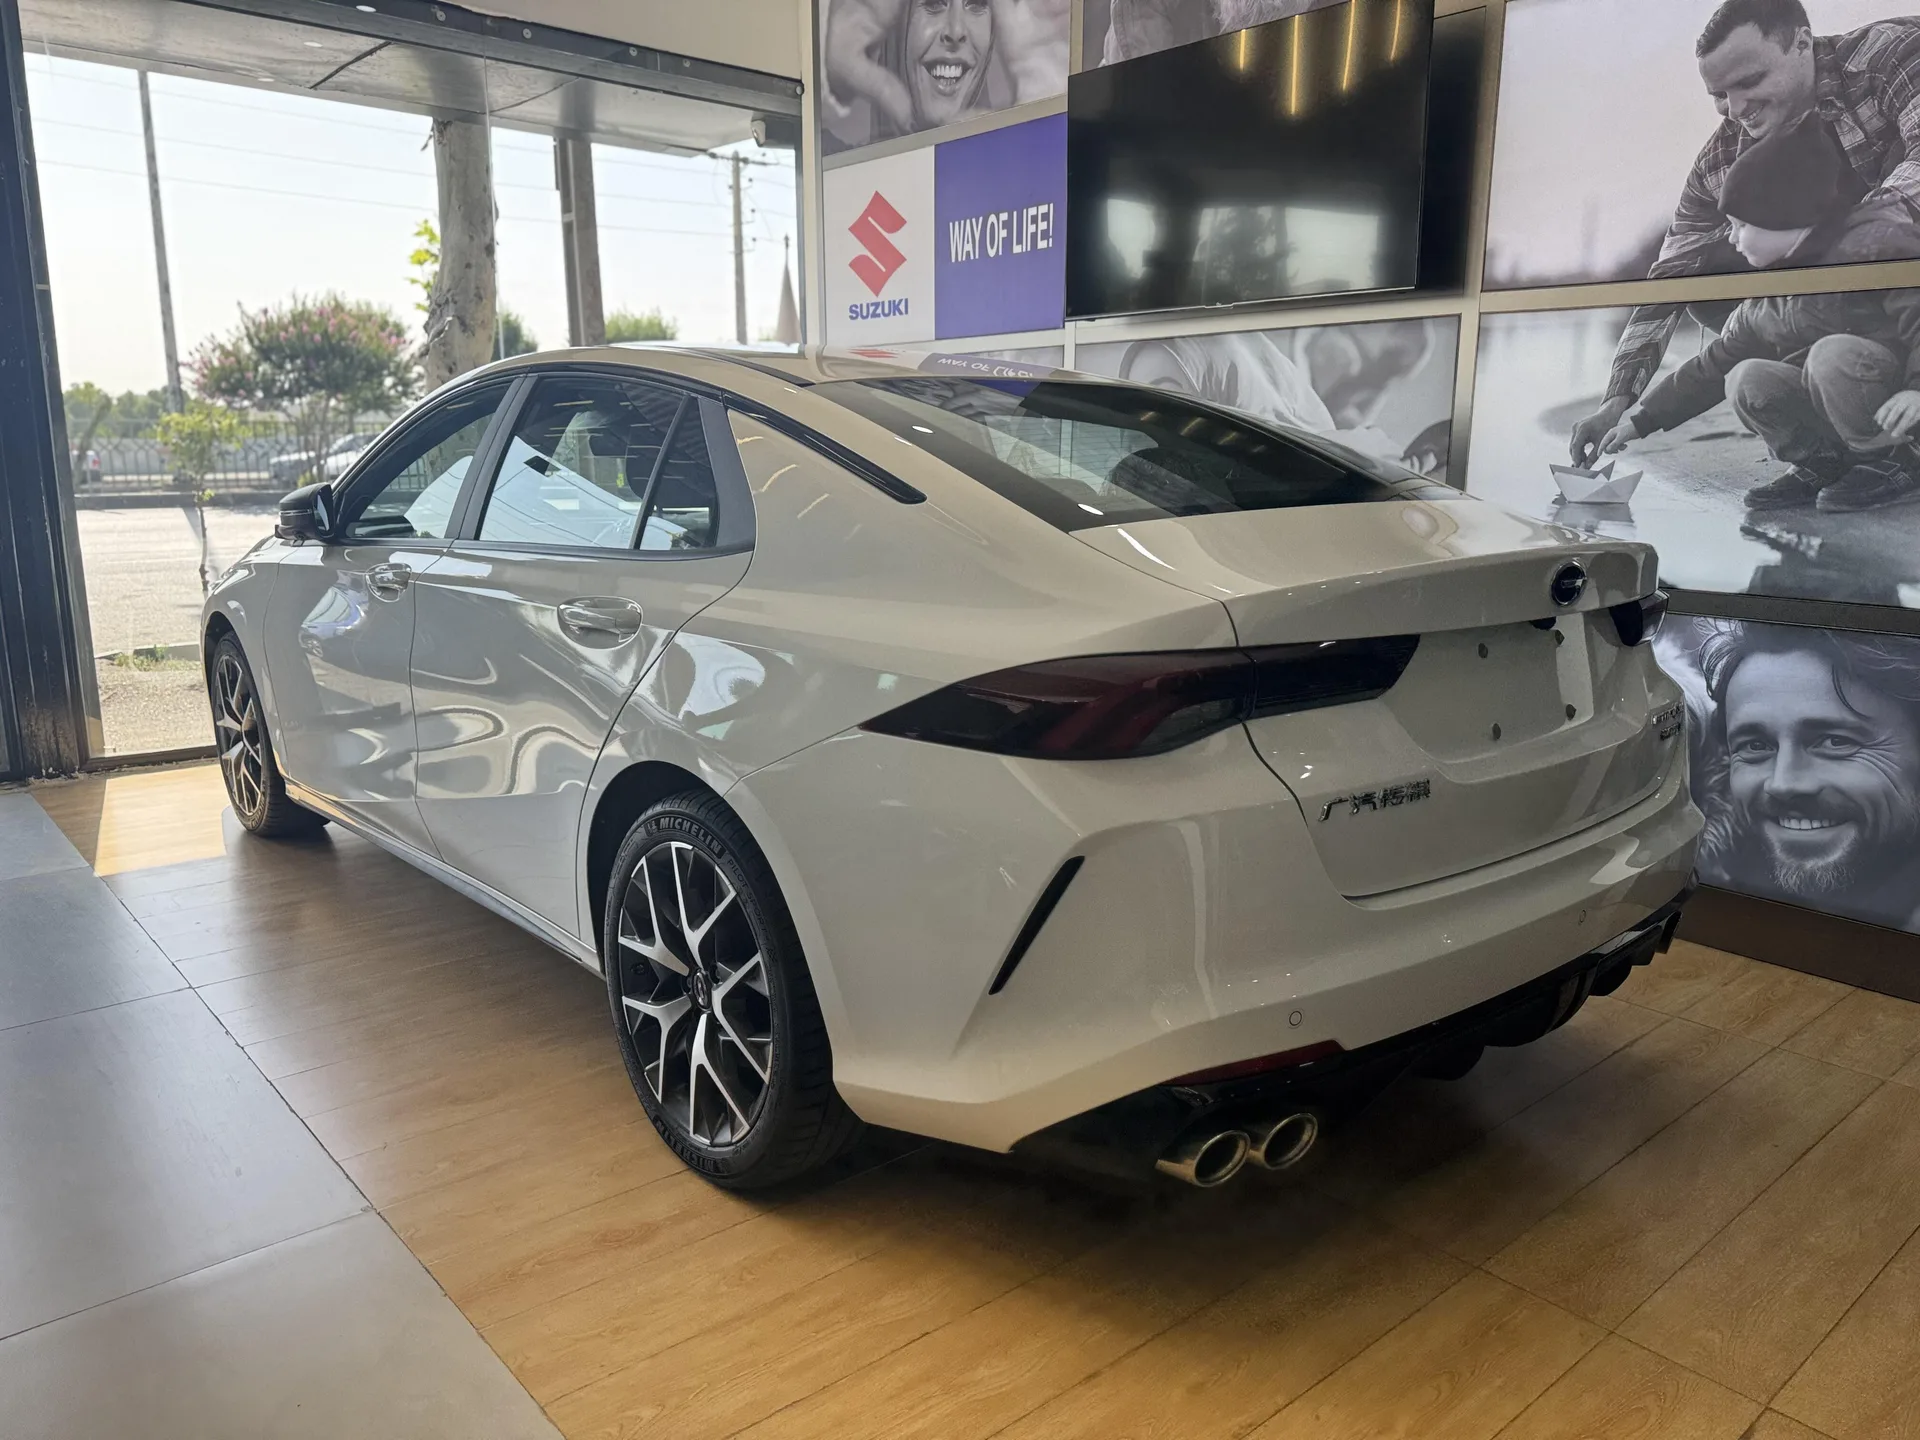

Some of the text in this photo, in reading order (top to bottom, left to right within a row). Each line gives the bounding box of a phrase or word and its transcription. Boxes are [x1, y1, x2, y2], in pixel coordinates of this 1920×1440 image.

[949, 203, 1054, 263] WAY OF LIFE!
[848, 298, 909, 320] SUZUKI
[659, 817, 722, 855] MICHELIN
[727, 859, 748, 888] PILOT
